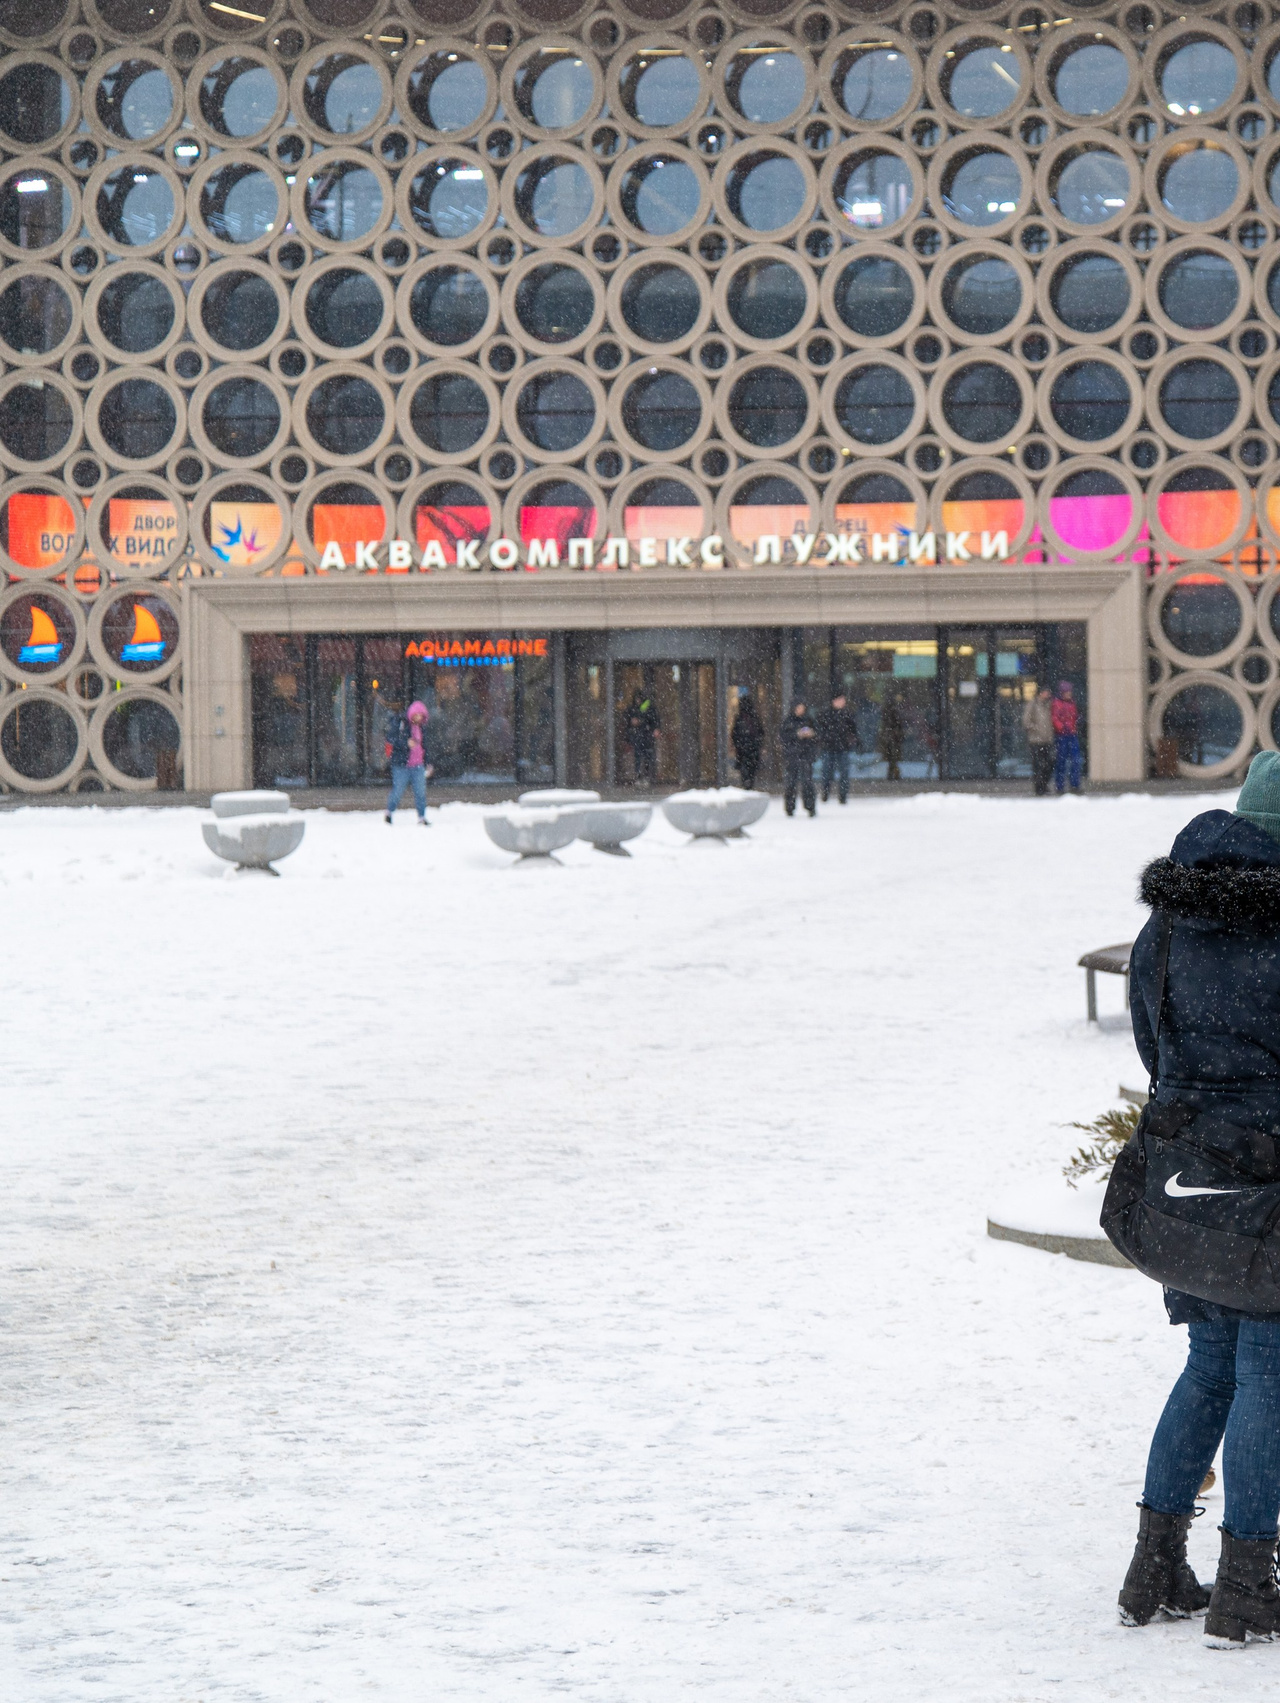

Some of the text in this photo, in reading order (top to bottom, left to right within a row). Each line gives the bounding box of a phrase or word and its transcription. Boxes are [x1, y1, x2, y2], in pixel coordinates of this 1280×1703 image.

[134, 515, 175, 531] ДВОР
[319, 535, 724, 571] АКВАКОМПЛЕКС
[753, 530, 1009, 565] ЛУЖНИКИ
[404, 638, 549, 659] AQUAMARINE
